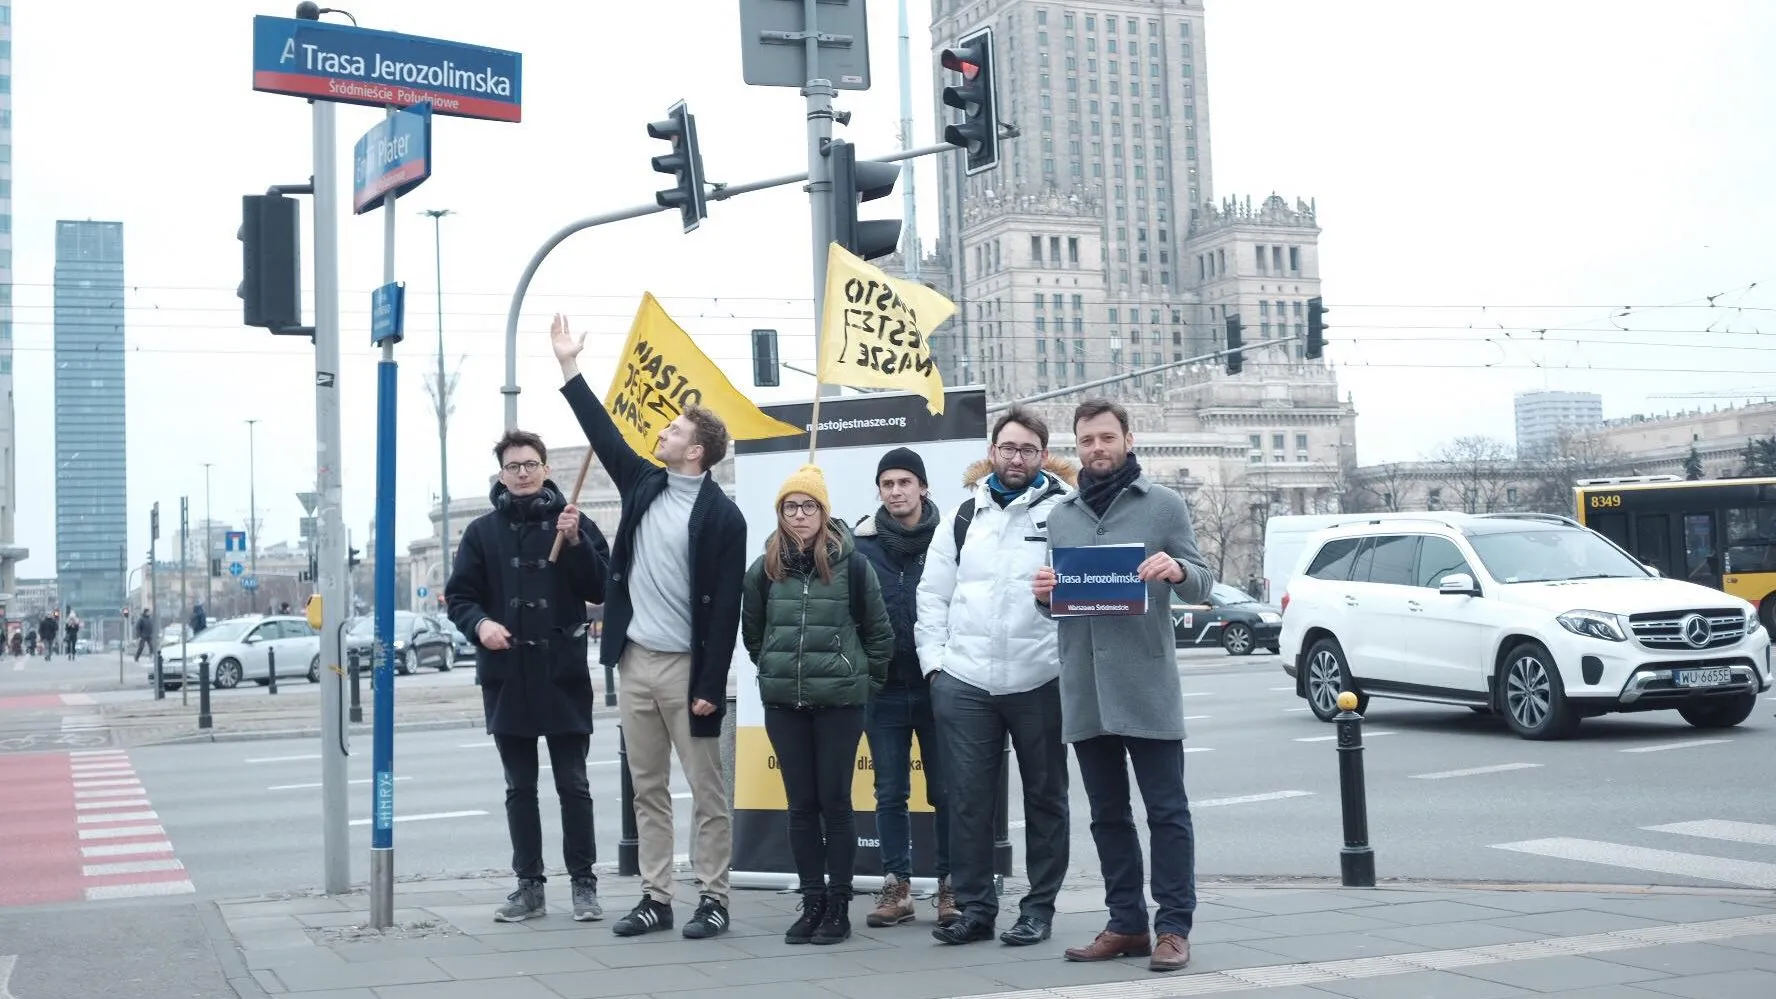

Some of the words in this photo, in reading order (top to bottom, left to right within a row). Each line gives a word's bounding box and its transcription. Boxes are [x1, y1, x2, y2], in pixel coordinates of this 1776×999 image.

[302, 44, 365, 76] Trasa
[371, 53, 511, 96] Jerozolimska
[328, 78, 393, 101] Śródmieście
[806, 416, 907, 432] mastojestnasze.org
[1591, 495, 1621, 508] 8349
[1057, 573, 1081, 584] Trasa
[1083, 572, 1140, 584] Jerozolimska
[1681, 671, 1698, 683] WU
[1701, 669, 1730, 683] 6655E
